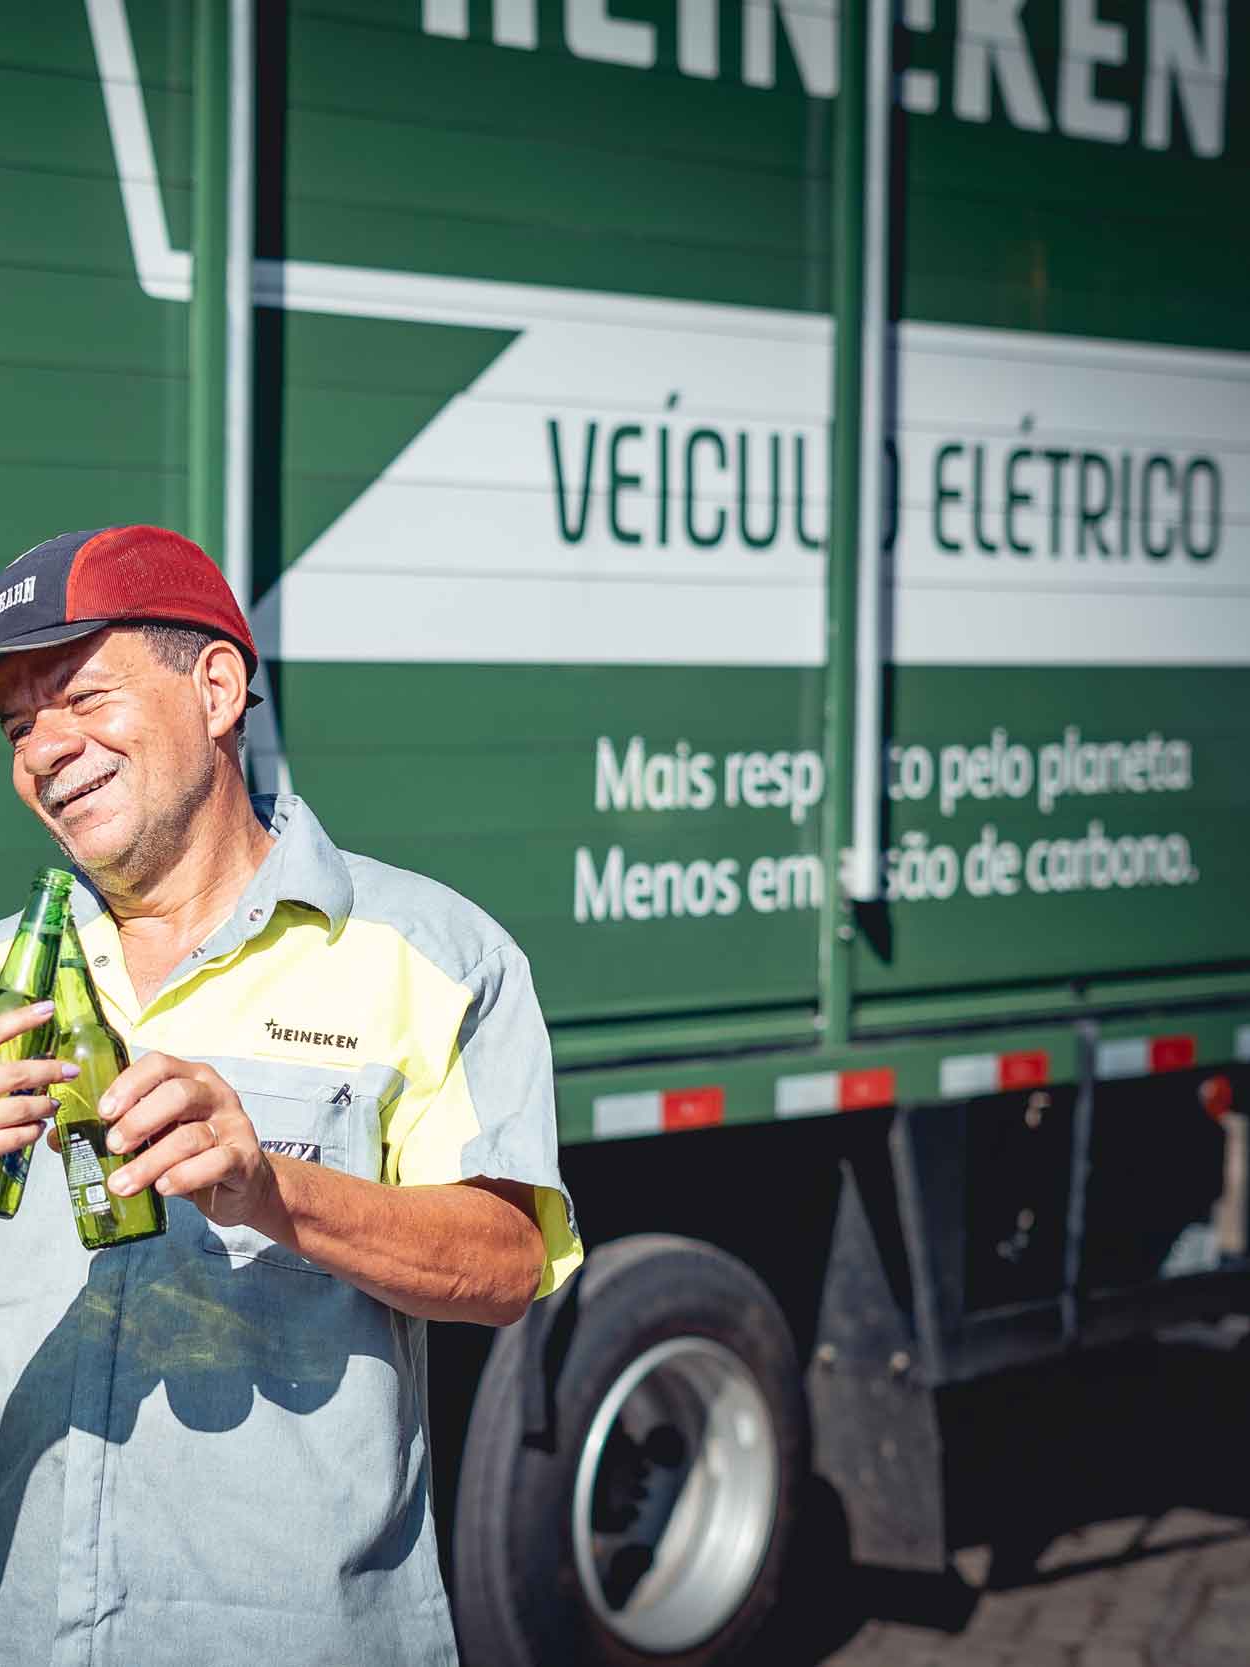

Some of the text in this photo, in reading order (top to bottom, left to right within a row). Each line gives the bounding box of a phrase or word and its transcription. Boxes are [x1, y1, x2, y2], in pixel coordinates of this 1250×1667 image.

[422, 0, 1228, 158] NKEN
[933, 413, 1221, 561] ELÉTRICO
[595, 725, 1192, 823] Mais respo pelo planeta
[574, 820, 1200, 922] Menos emão de carbono.
[271, 1028, 358, 1049] HEINEKEN
